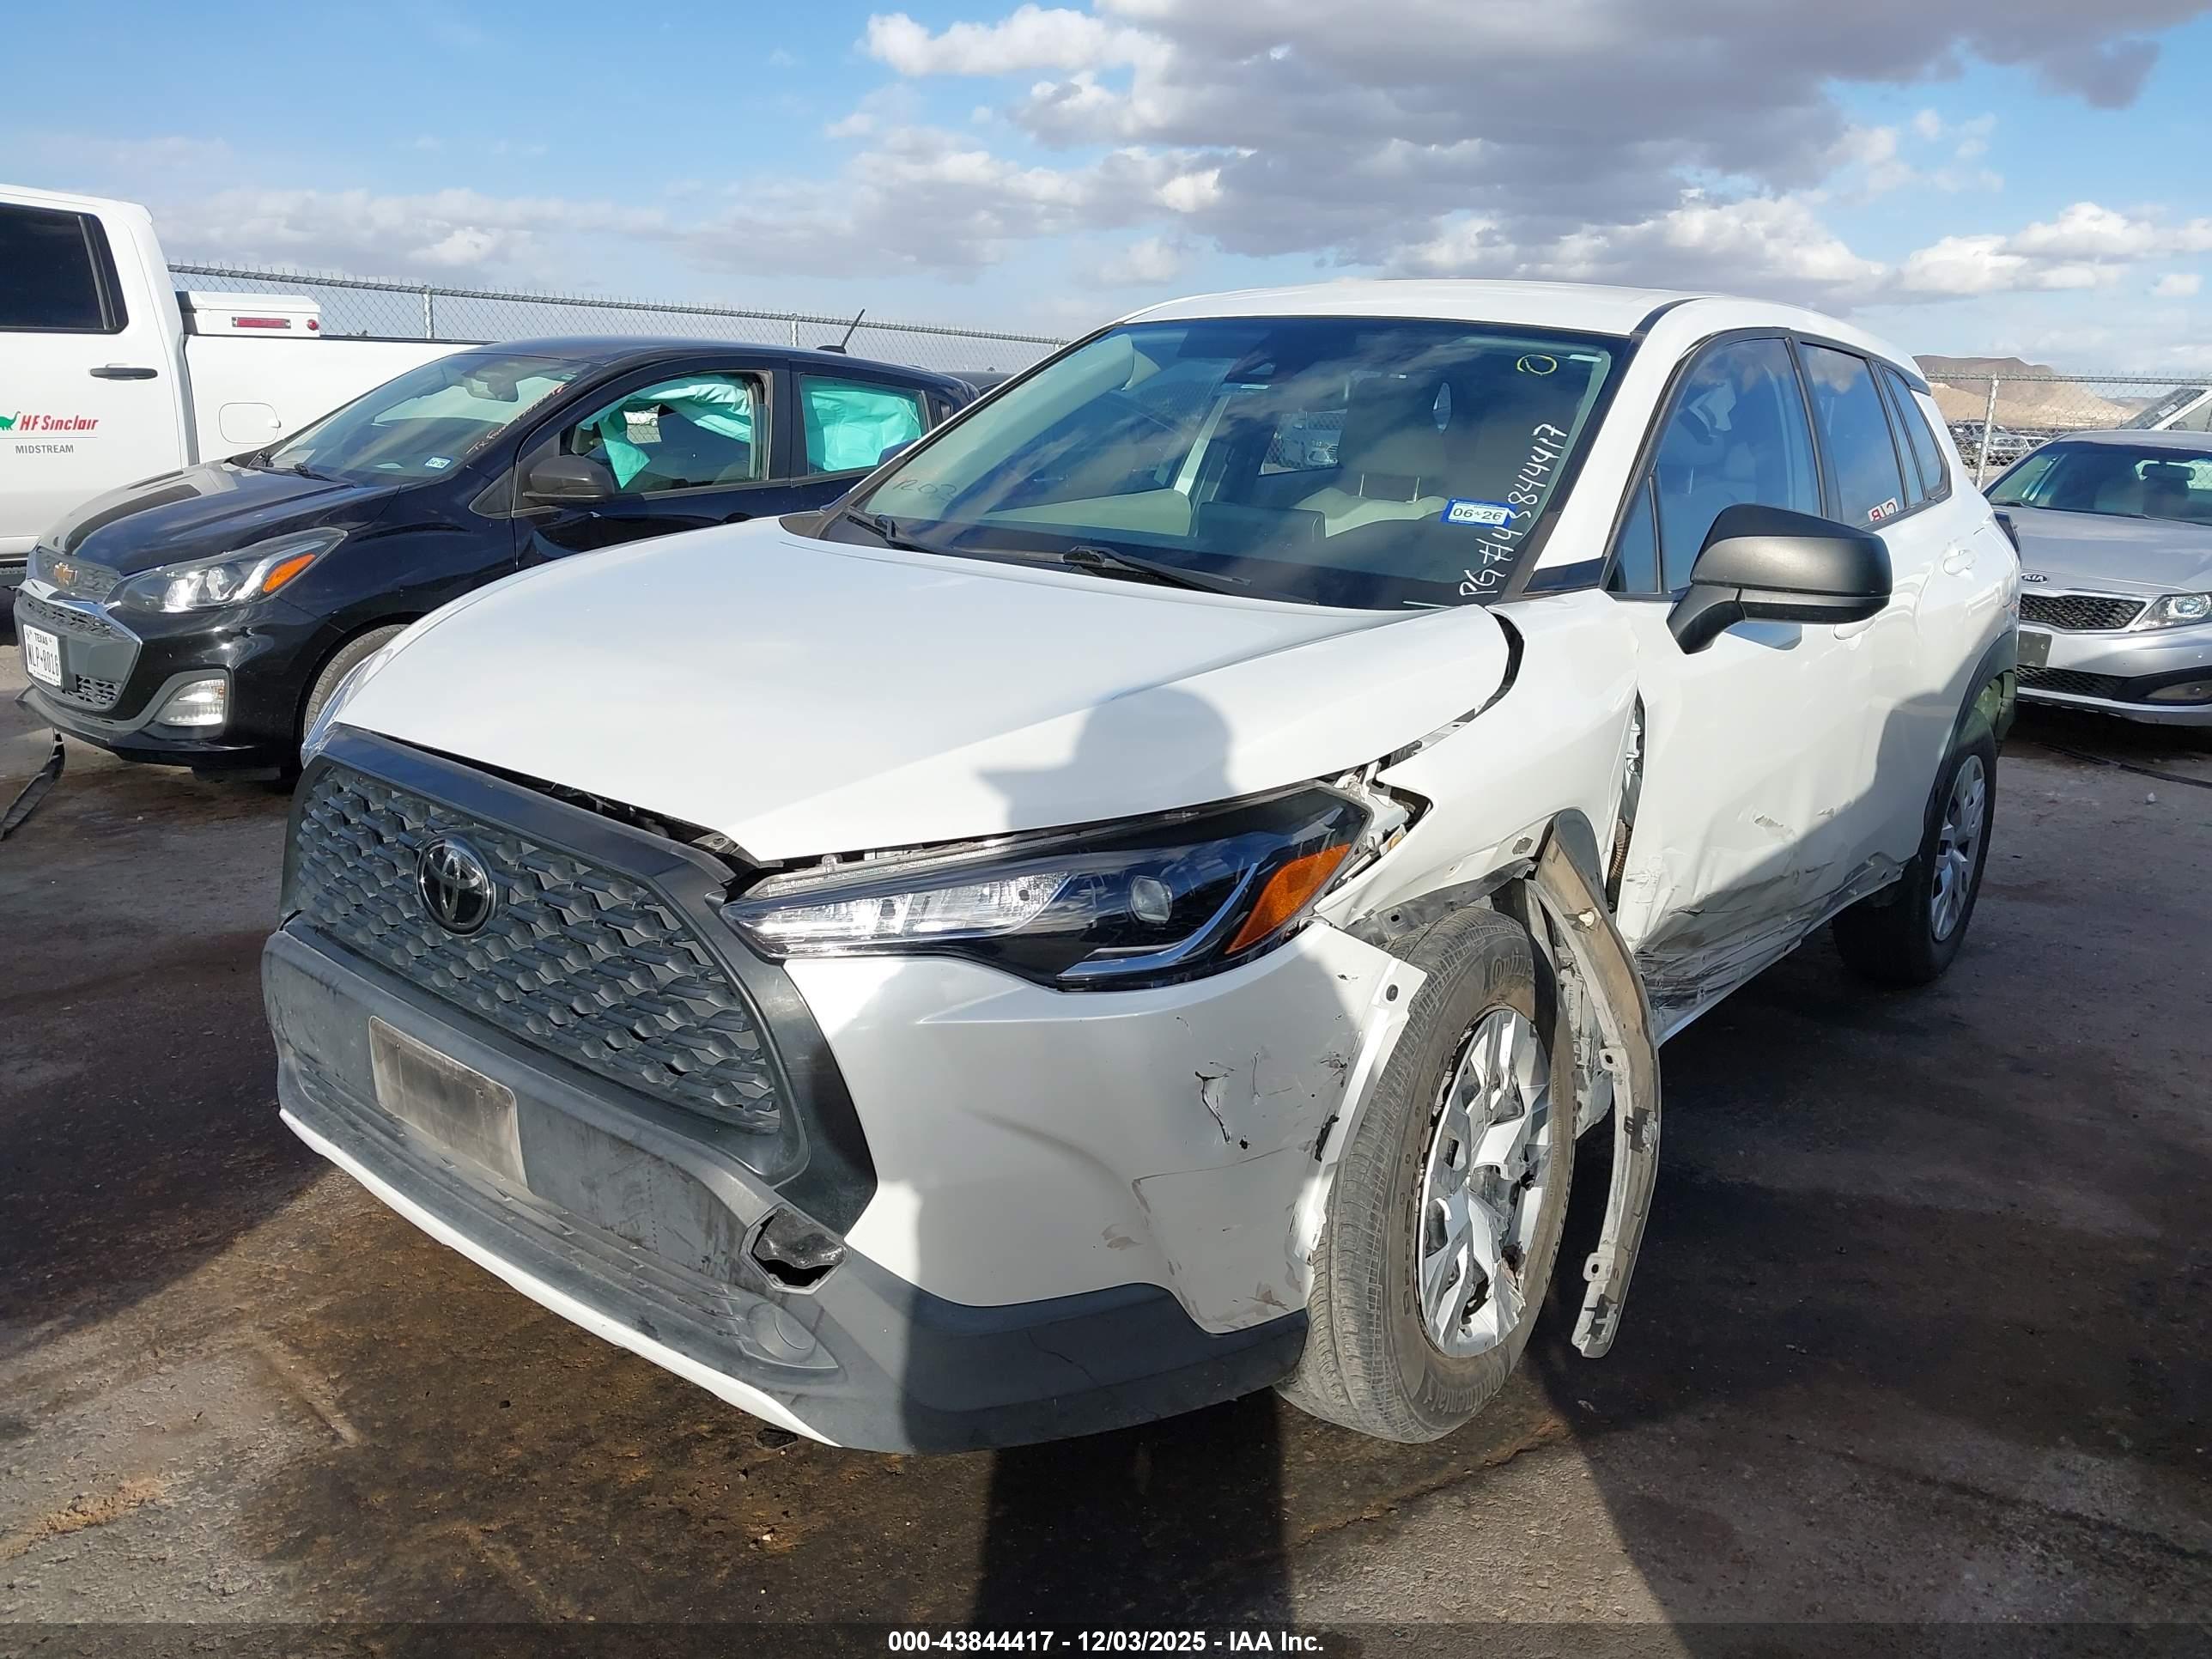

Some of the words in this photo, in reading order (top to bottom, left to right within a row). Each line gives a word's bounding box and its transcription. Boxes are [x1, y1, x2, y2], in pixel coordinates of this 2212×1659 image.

[19, 415, 40, 430] HF
[41, 415, 99, 430] Sinclair
[15, 445, 74, 453] MIDSTREAM
[34, 632, 48, 646] TEXAS
